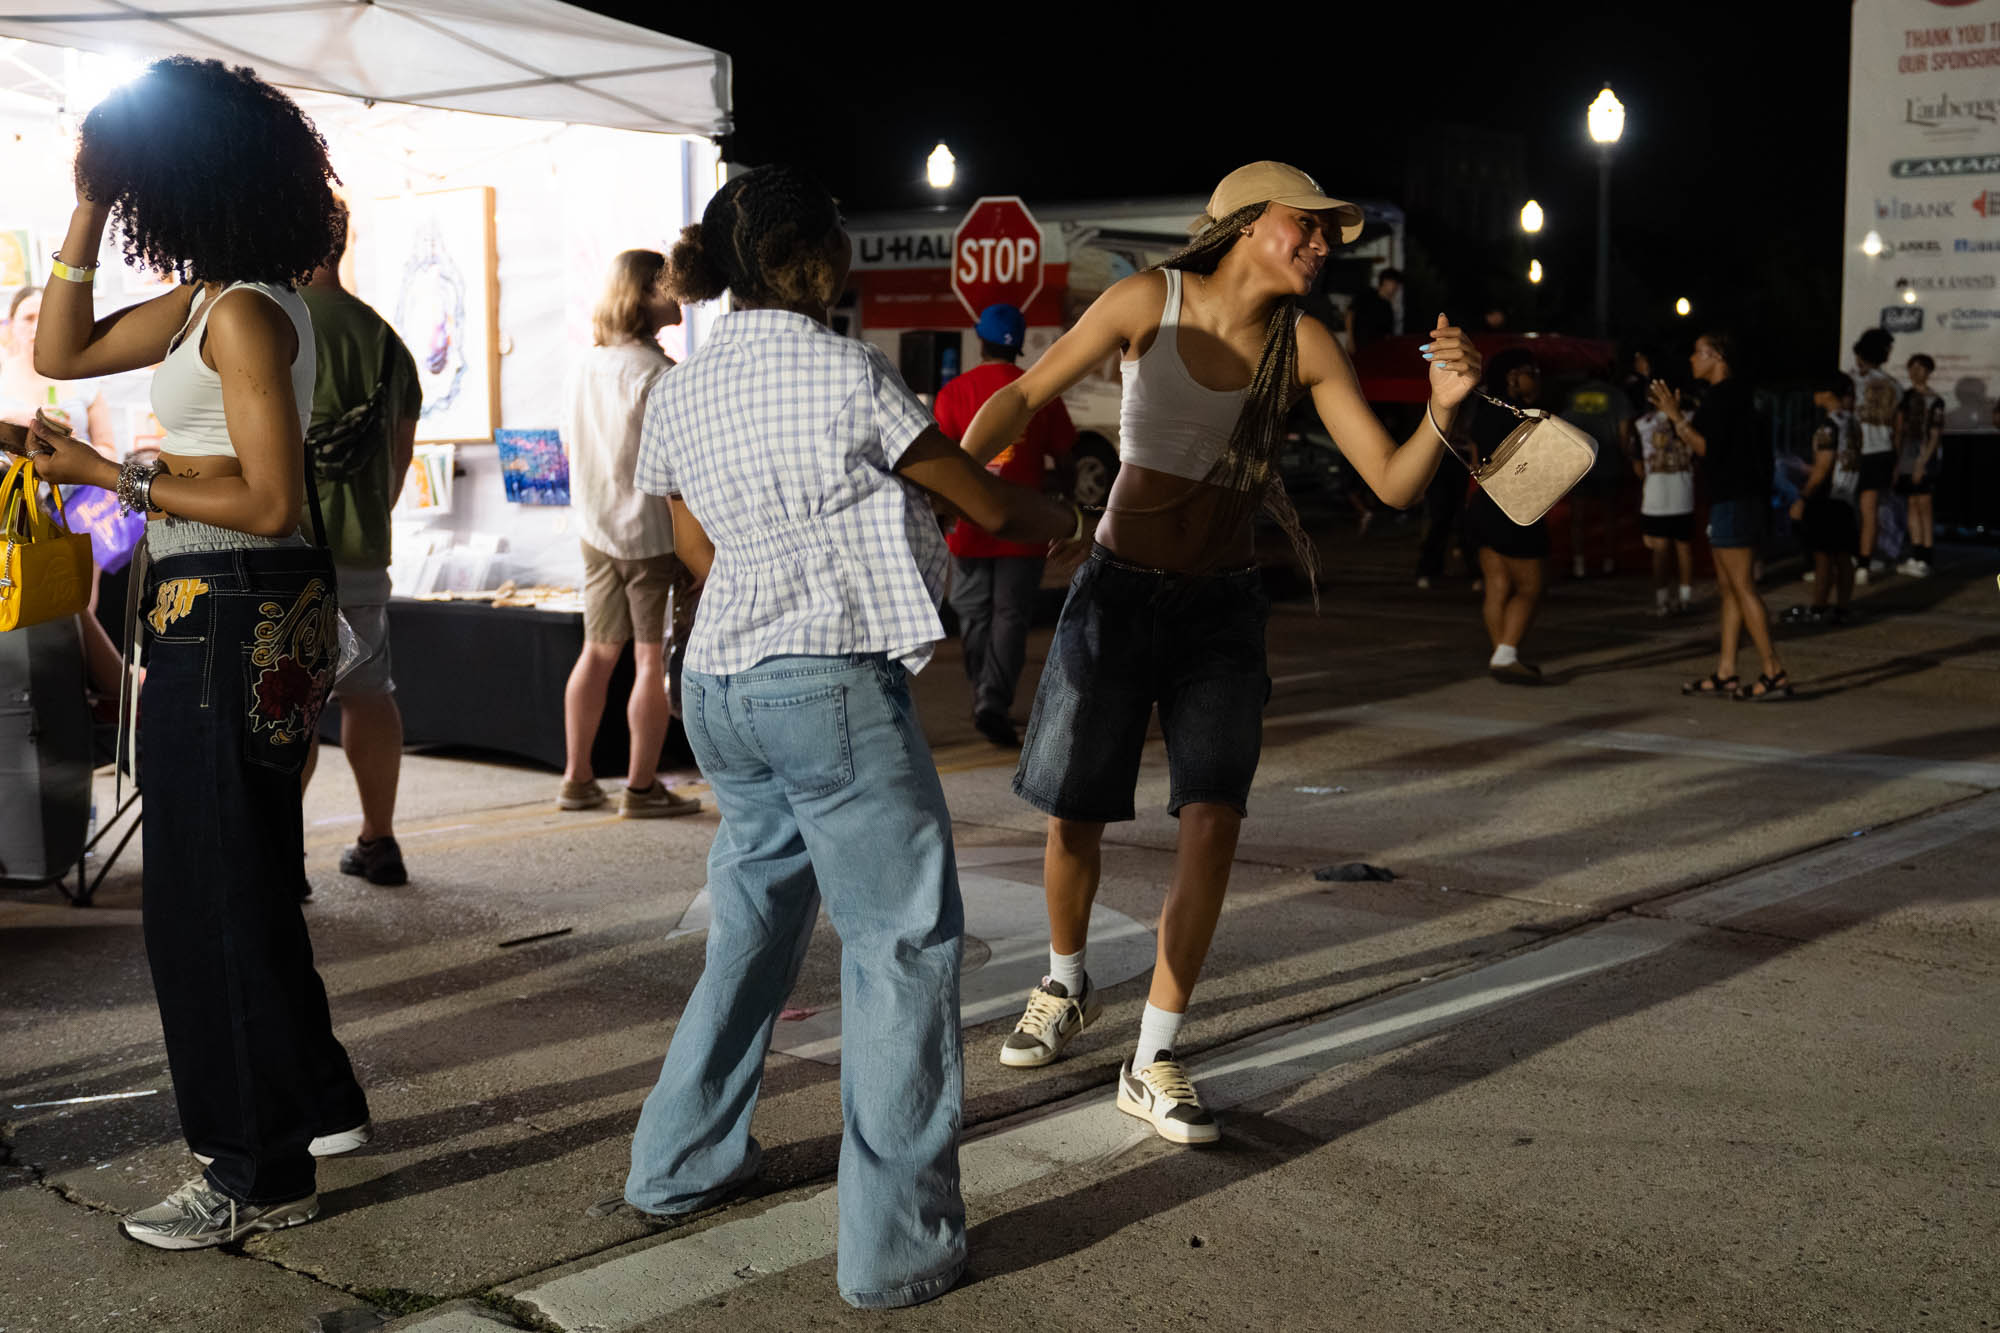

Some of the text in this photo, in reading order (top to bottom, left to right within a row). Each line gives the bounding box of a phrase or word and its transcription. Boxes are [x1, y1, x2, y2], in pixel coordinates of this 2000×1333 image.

[1905, 21, 2000, 48] THANK YOU T
[1898, 54, 1927, 73] OUR
[861, 236, 952, 262] U-HAU
[959, 238, 1037, 283] STOP
